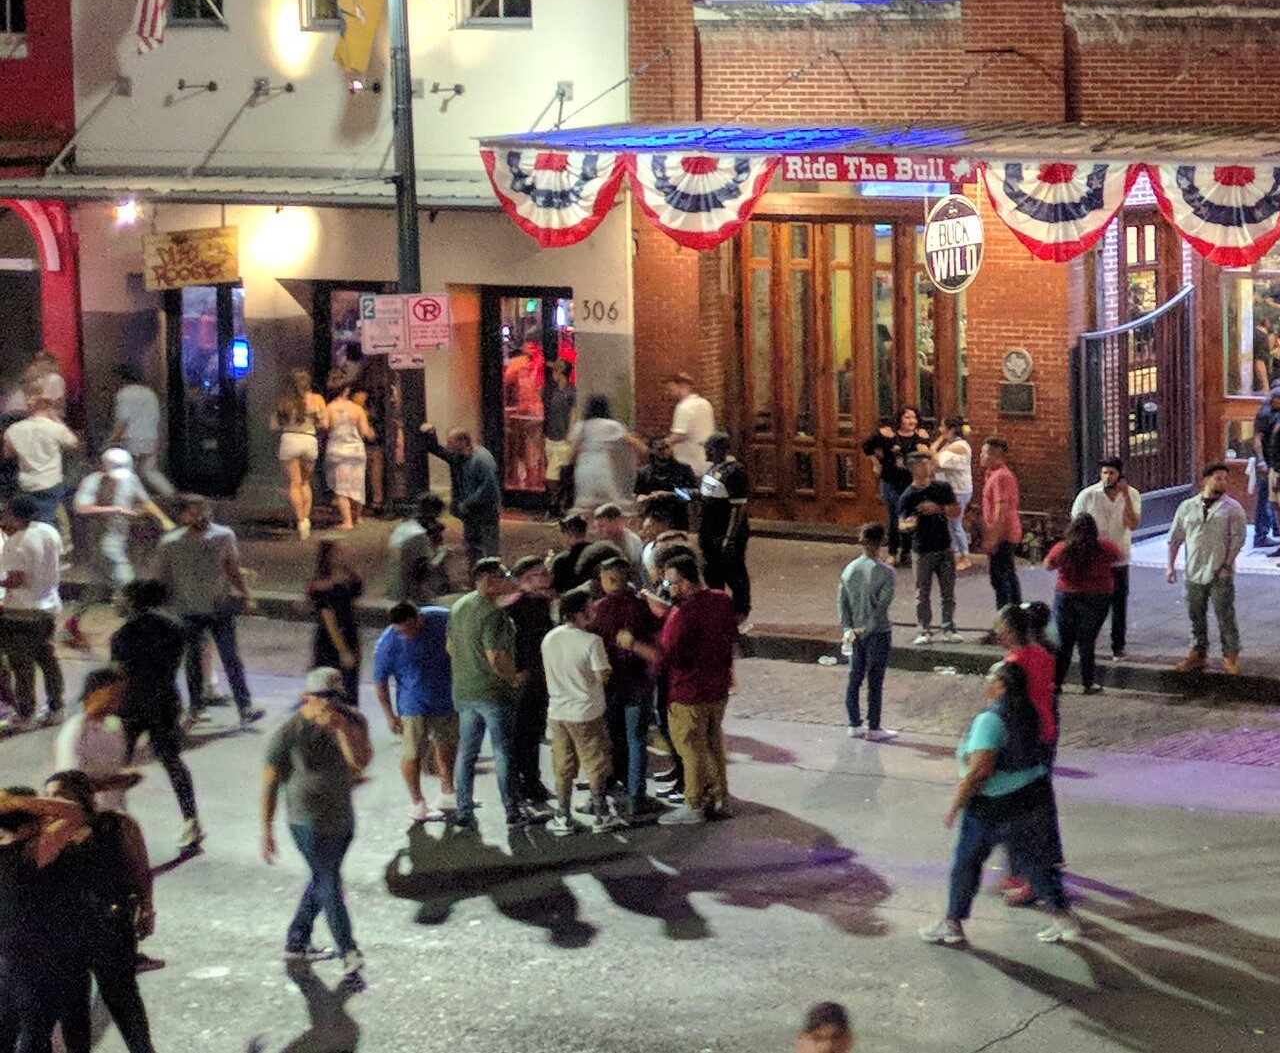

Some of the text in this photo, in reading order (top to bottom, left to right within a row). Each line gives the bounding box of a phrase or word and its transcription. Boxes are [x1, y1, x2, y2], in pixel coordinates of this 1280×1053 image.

[786, 155, 945, 181] Ride The Bull
[938, 221, 970, 247] BUCK
[932, 245, 977, 282] WILD
[582, 299, 619, 321] 306
